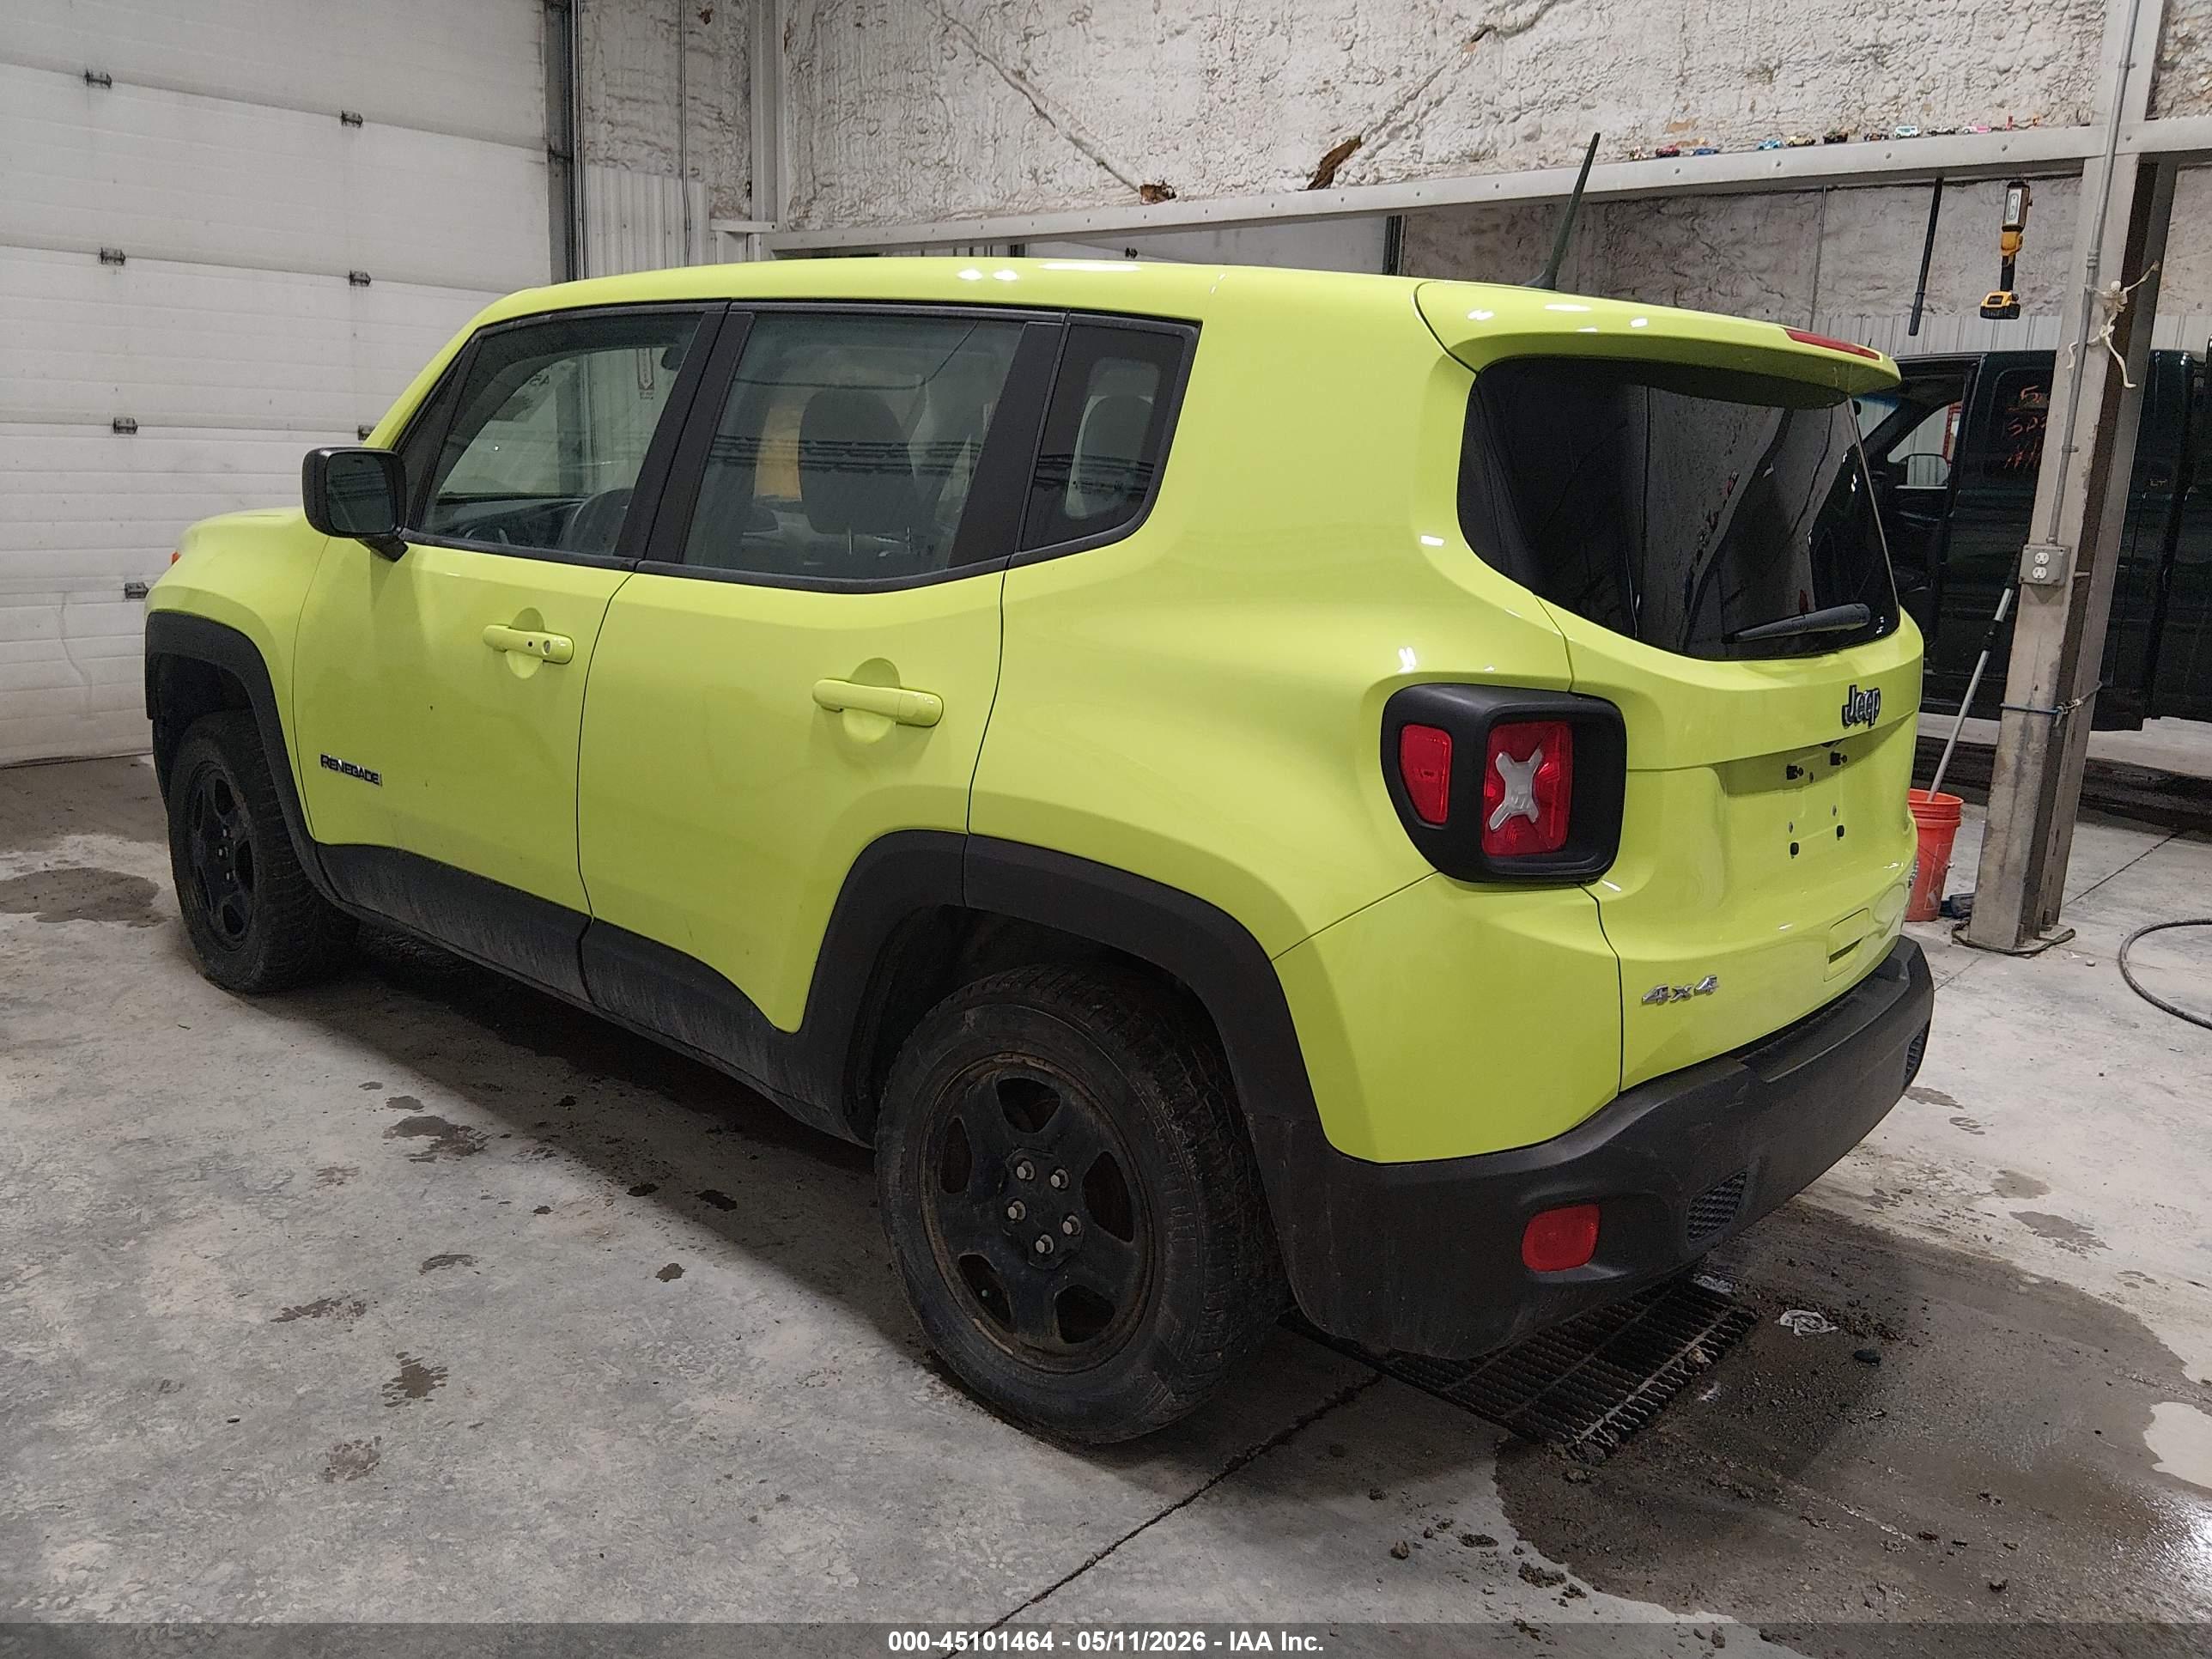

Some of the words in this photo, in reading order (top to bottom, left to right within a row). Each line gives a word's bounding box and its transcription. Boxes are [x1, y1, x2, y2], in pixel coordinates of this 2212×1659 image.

[1841, 684, 1881, 730] Jeep
[319, 753, 383, 787] RENEGADE
[1641, 974, 1718, 1006] 4x4
